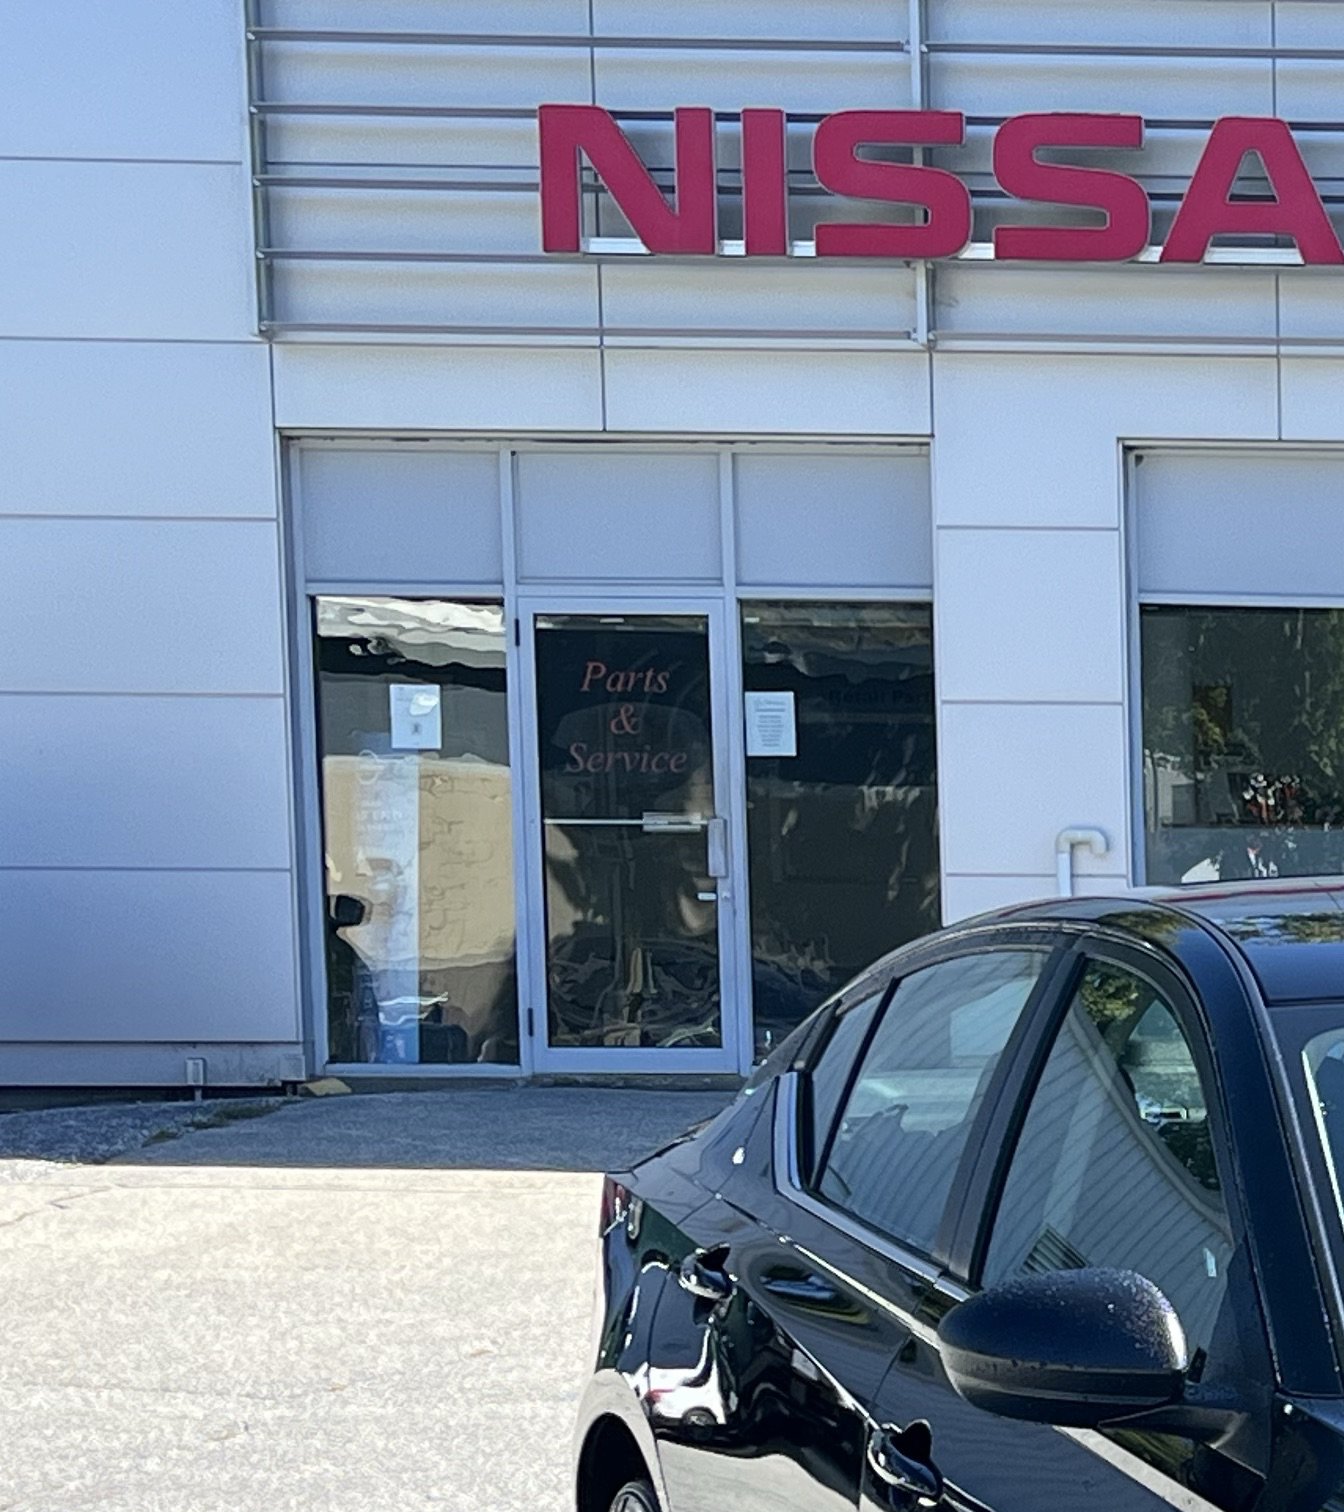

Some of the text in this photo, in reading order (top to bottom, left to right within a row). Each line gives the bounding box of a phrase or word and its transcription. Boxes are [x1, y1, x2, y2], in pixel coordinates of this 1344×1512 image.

[580, 661, 670, 694] Parts
[609, 702, 641, 735] &
[564, 741, 687, 774] Service
